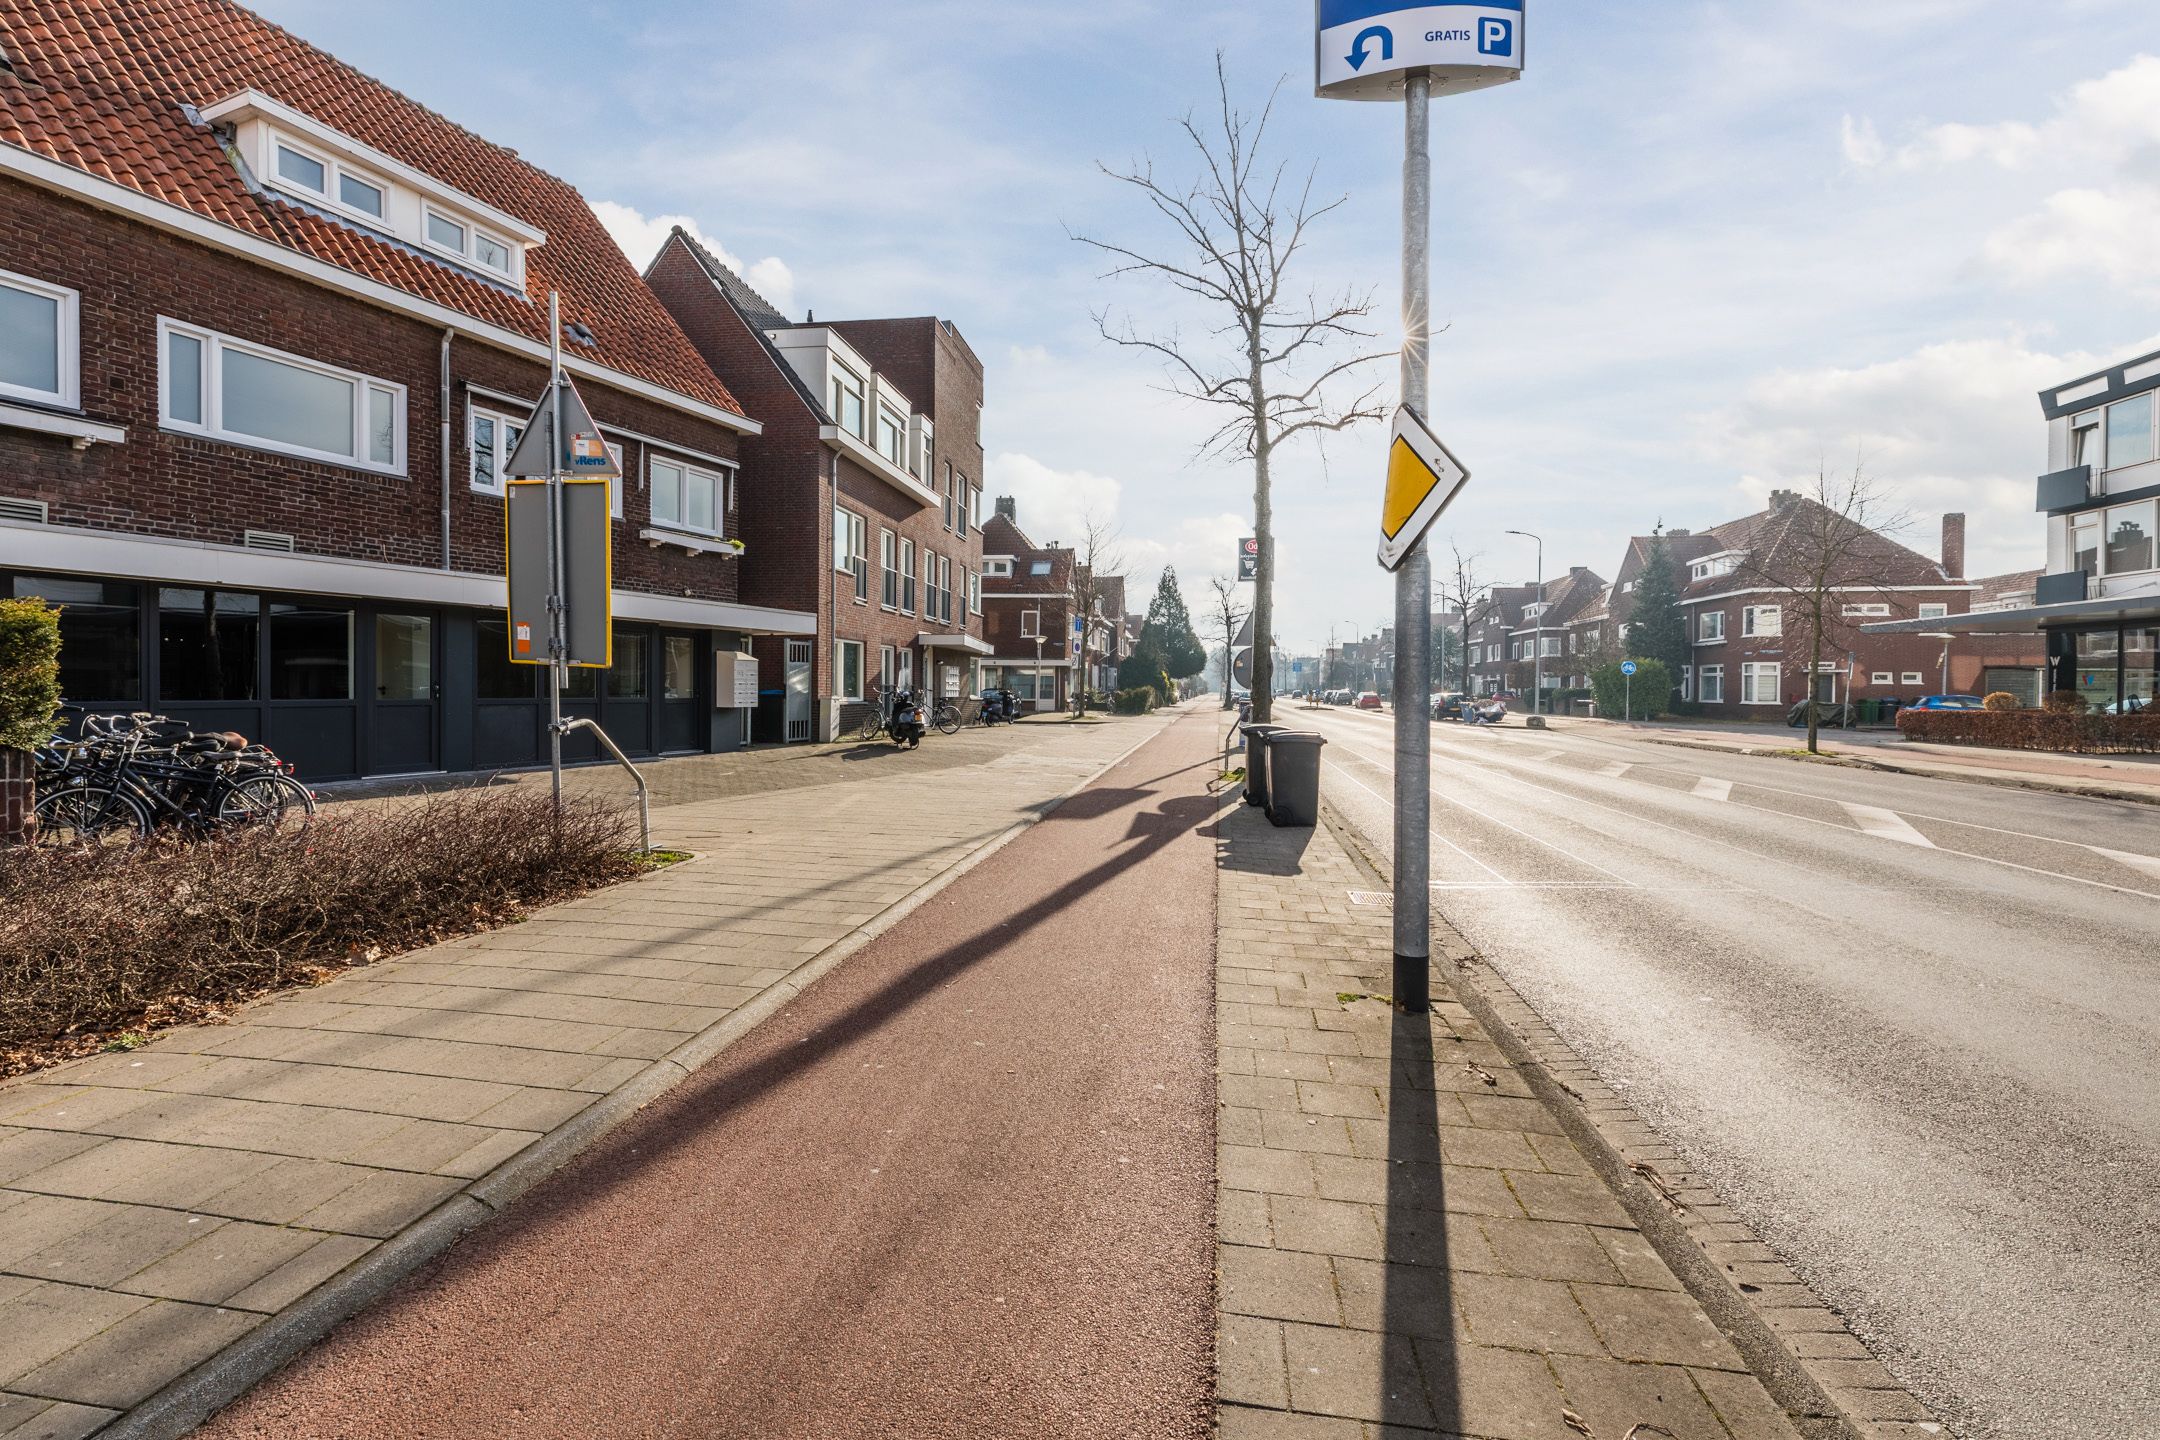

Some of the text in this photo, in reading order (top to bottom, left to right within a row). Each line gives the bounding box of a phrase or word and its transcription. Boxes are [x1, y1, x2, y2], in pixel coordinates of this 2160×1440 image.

[1424, 20, 1506, 51] GRATIS P
[1248, 542, 1258, 550] Od
